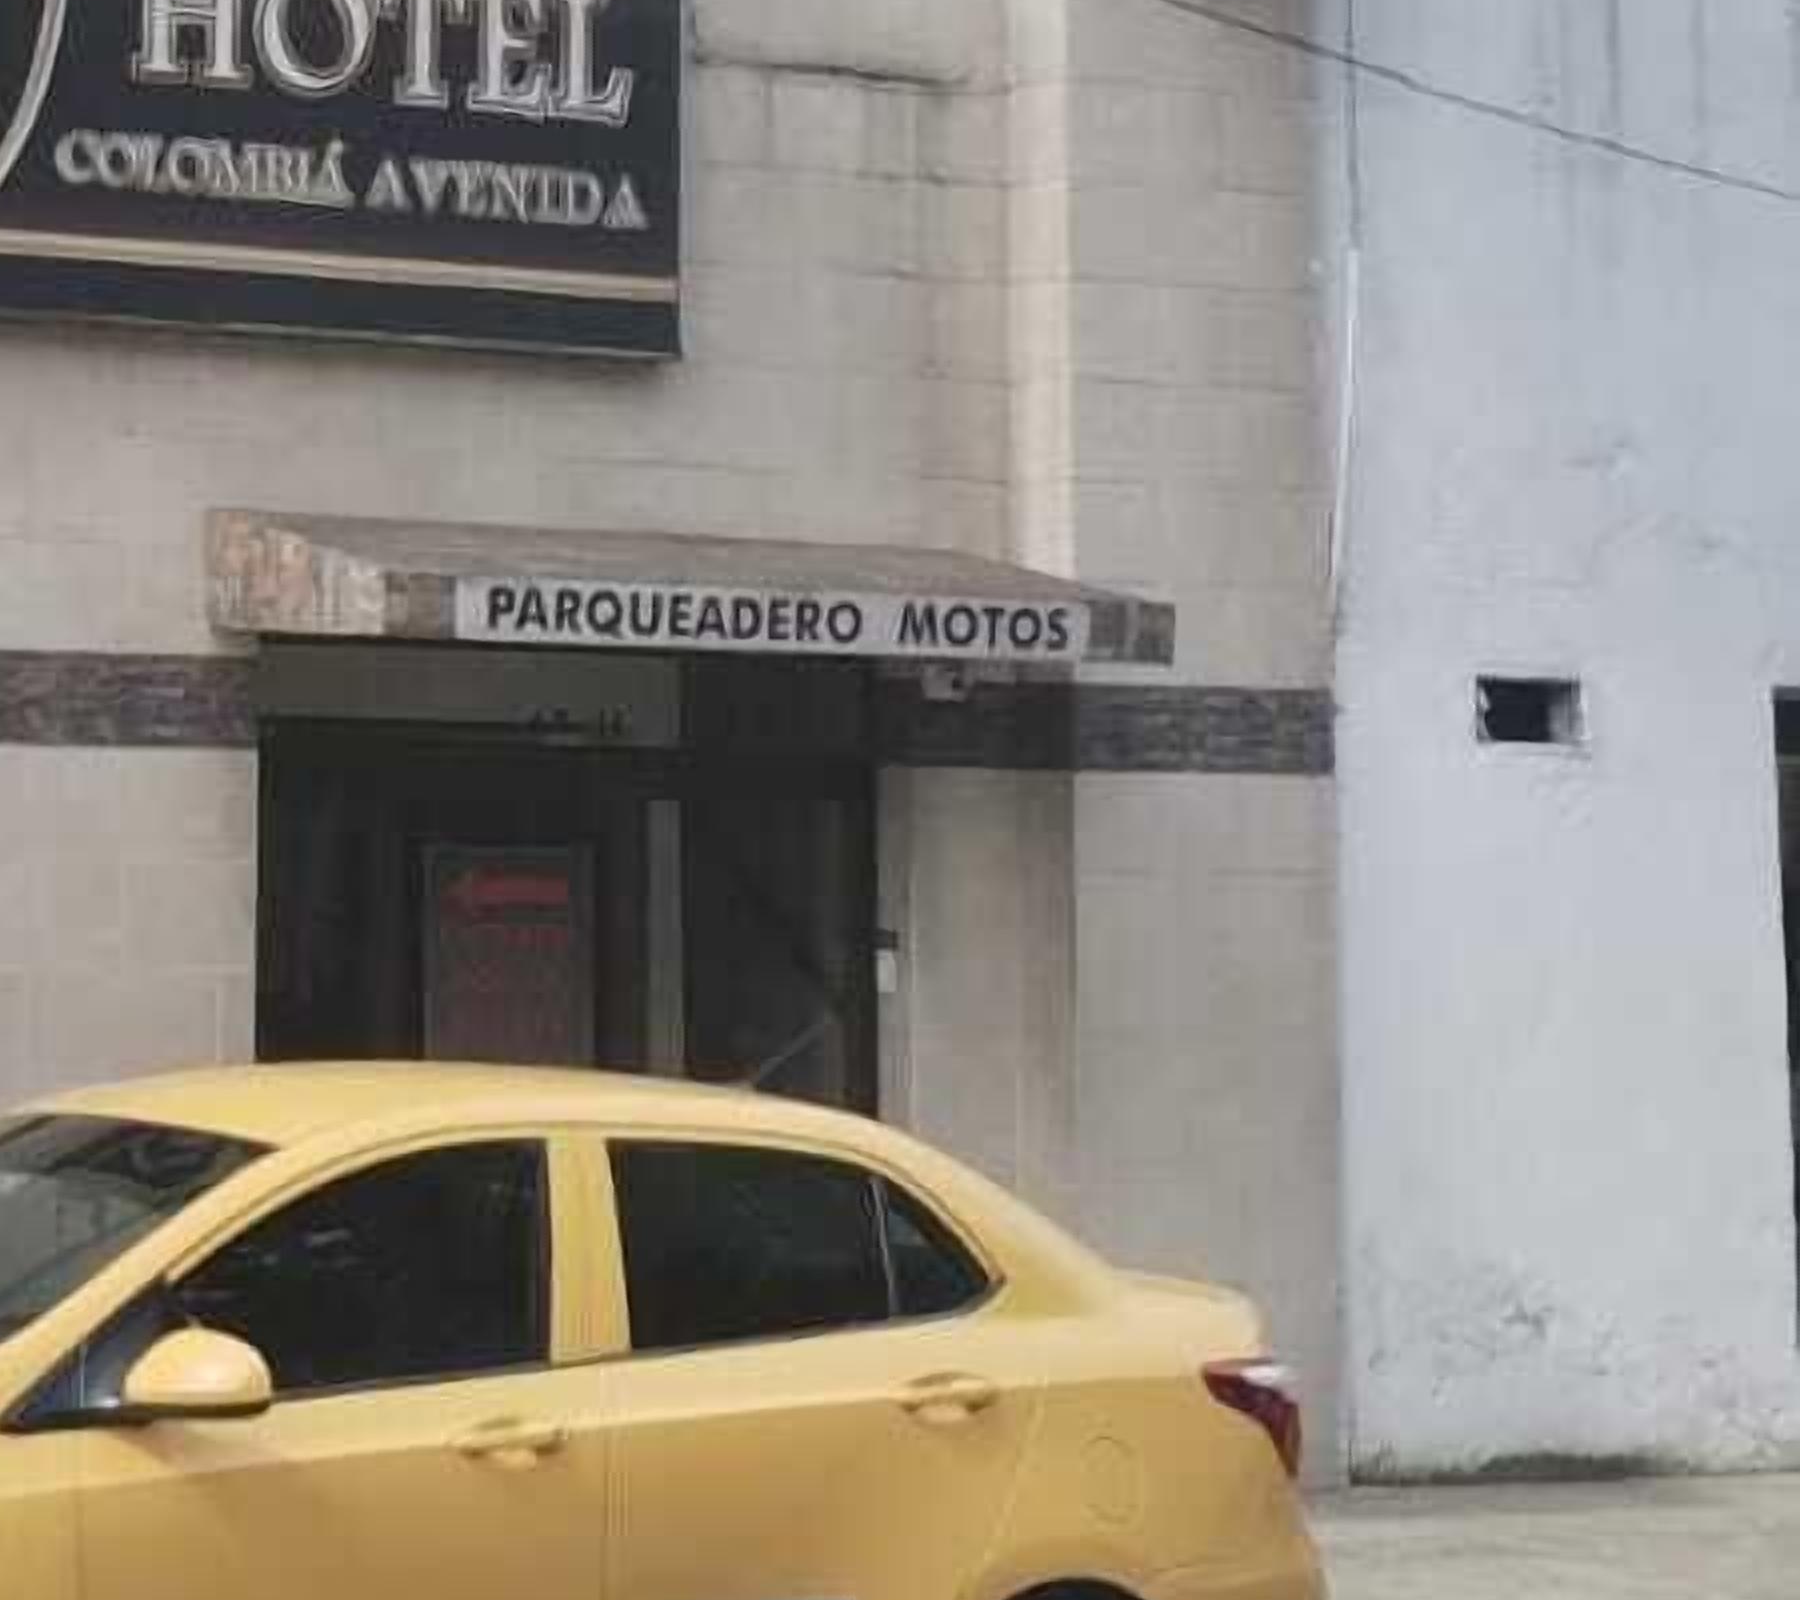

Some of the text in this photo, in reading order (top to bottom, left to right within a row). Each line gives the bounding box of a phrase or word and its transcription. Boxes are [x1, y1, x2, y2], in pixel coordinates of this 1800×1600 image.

[364, 155, 649, 231] AVENIDA
[486, 586, 1070, 651] PARQUEADERO MOTOS
